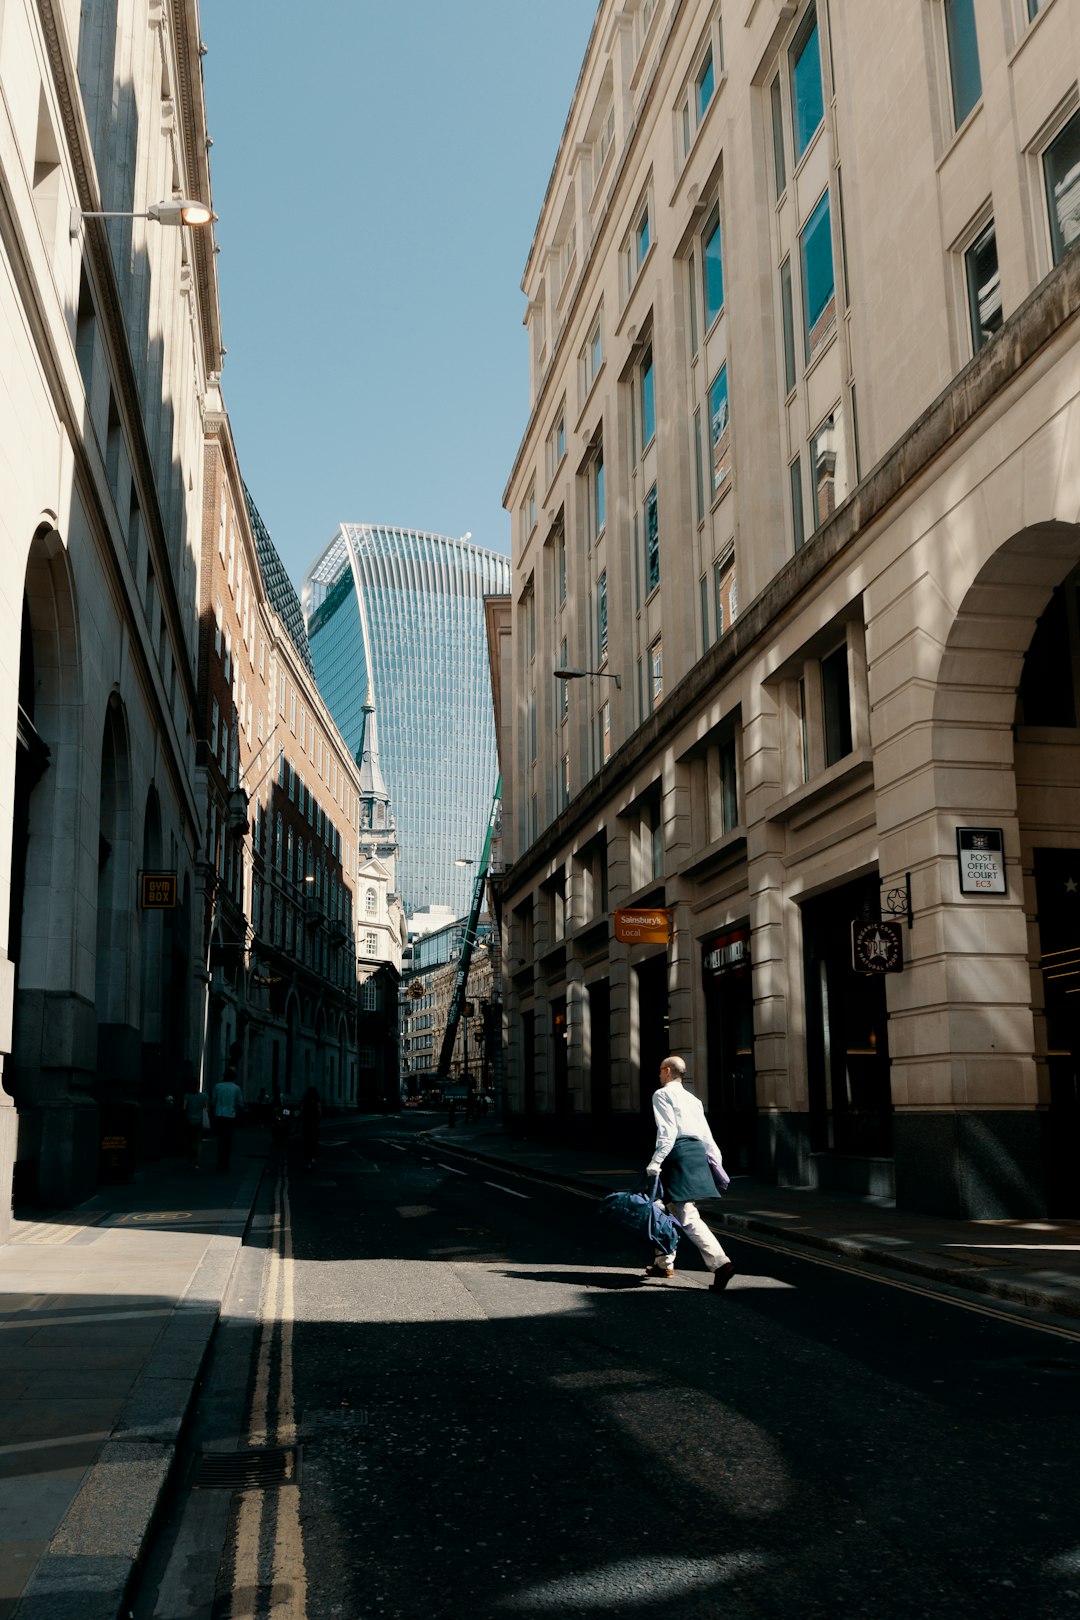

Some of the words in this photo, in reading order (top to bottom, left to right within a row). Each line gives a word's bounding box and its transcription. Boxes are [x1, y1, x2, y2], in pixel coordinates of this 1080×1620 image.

[970, 853, 993, 862] POST
[967, 862, 997, 871] OFFICE
[967, 871, 998, 880] COURT
[149, 881, 170, 892] GYM
[975, 880, 992, 888] EC3
[149, 892, 169, 902] BOX
[620, 915, 662, 926] Sainsbury's
[621, 929, 641, 937] Local
